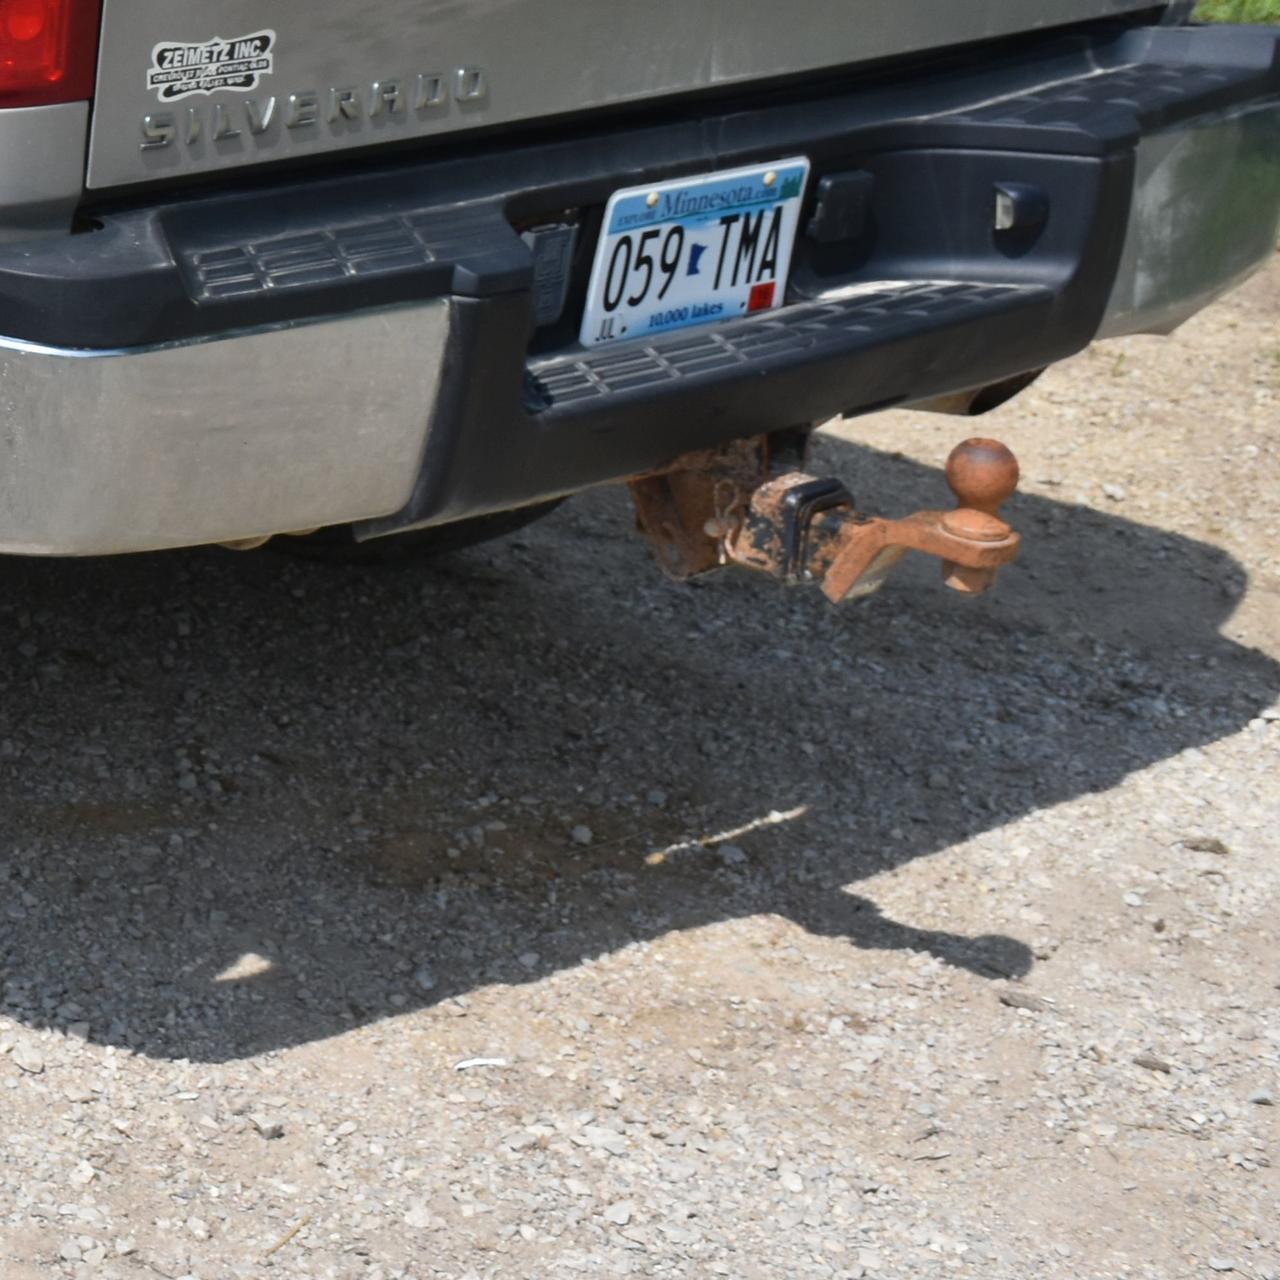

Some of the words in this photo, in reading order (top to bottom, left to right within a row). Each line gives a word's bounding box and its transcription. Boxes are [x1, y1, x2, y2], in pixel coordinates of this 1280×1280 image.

[161, 44, 230, 69] ZEIMETZ
[139, 64, 489, 151] SILVERADO
[603, 225, 685, 312] 059
[713, 205, 784, 291] TMA
[691, 302, 724, 319] lakes
